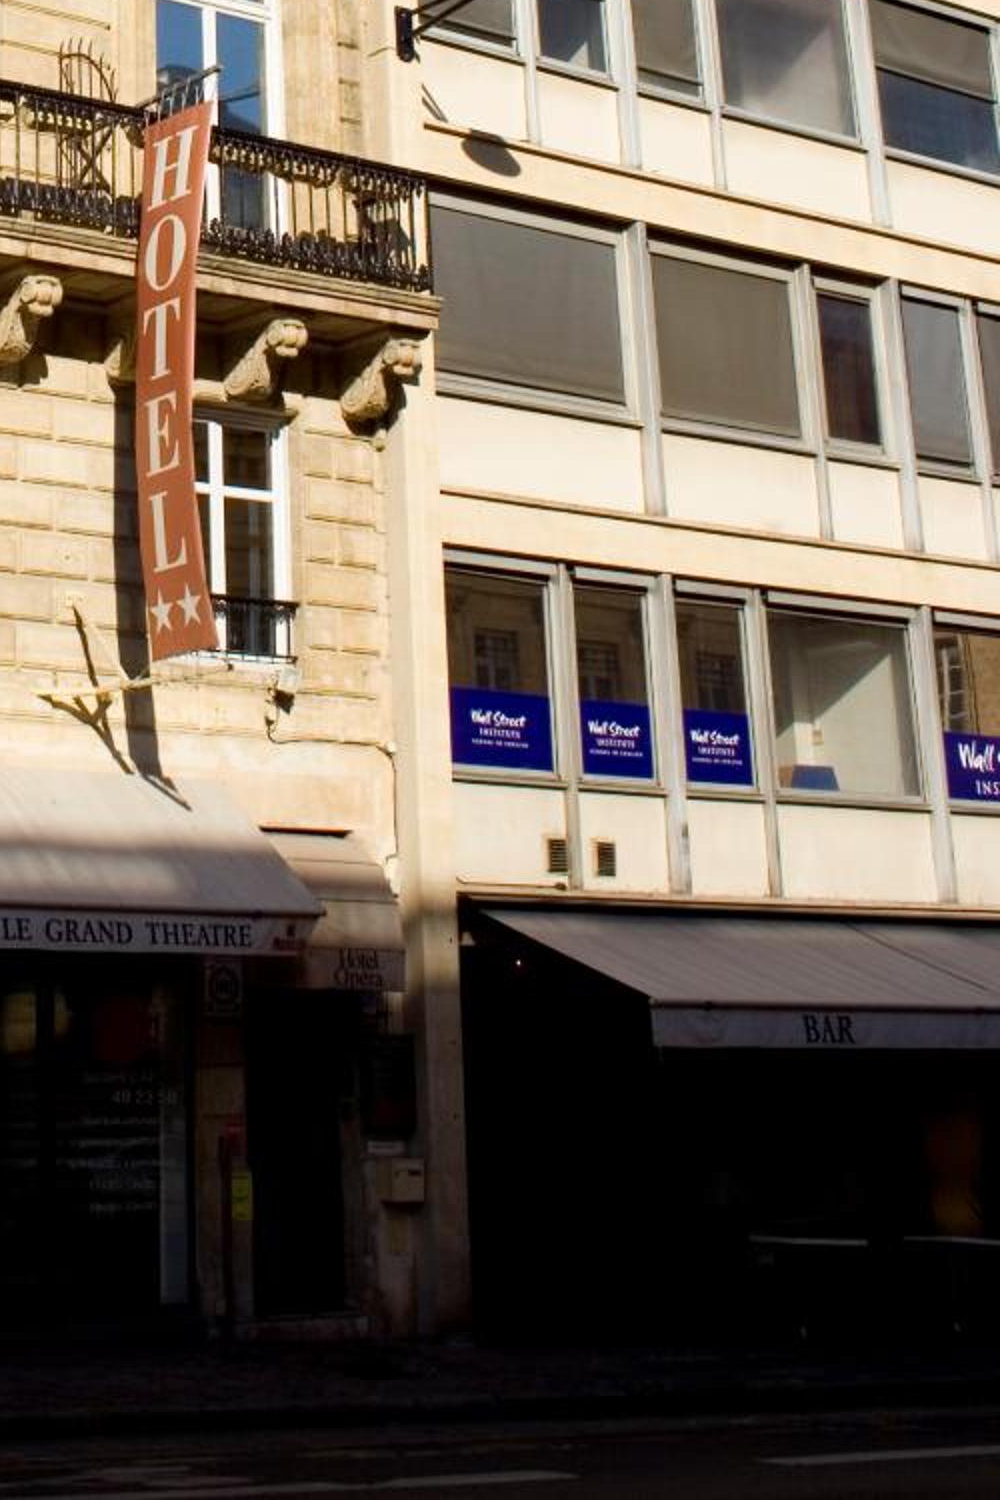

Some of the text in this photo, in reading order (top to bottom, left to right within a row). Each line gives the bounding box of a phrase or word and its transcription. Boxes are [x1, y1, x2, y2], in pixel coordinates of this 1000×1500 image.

[144, 124, 198, 573] HOTEL
[494, 711, 526, 728] Street
[609, 721, 640, 738] Street
[710, 730, 739, 746] Street
[957, 740, 995, 773] Wall
[1, 917, 33, 942] LE
[45, 918, 133, 945] GRAND
[145, 920, 252, 948] THEATRE
[803, 1014, 856, 1045] BAR
